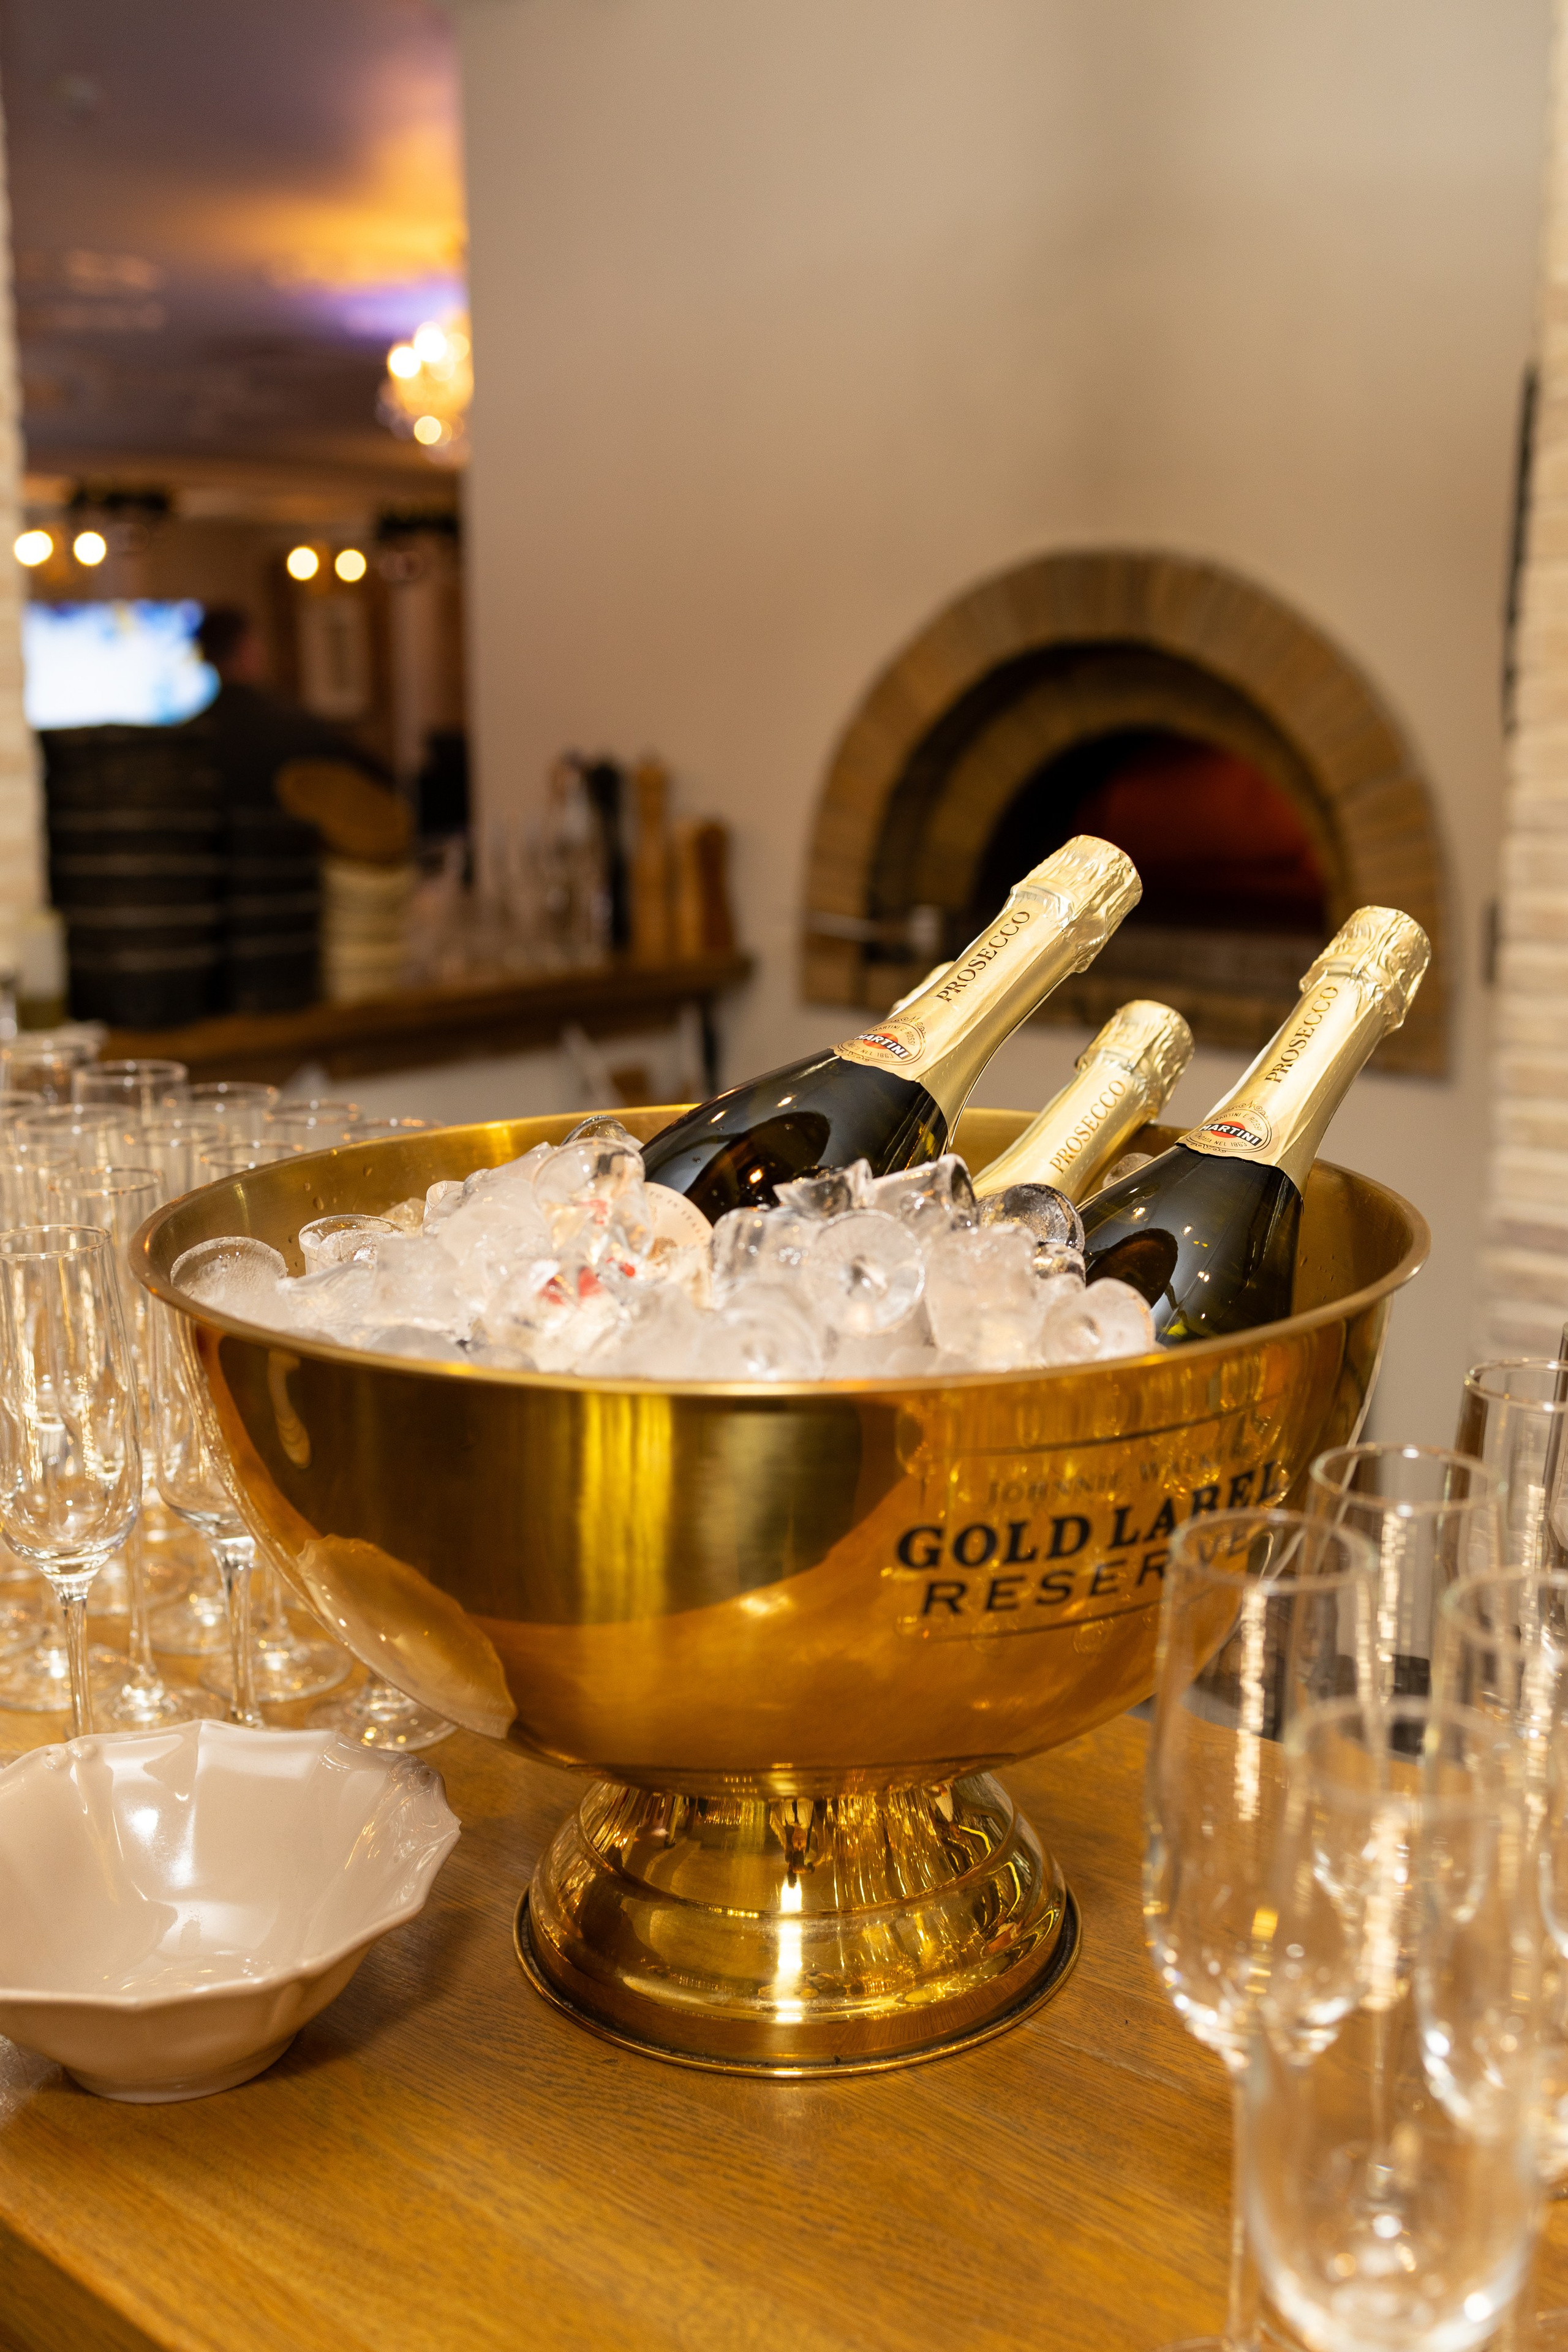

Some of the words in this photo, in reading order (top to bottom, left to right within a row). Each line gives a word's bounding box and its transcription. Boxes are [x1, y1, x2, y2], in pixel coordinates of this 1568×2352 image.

[936, 911, 1030, 1002] PROSECCO
[854, 1034, 910, 1058] MARTINI
[905, 1031, 916, 1046] ROSSI
[1264, 987, 1338, 1084] PROSECCO
[1050, 1080, 1126, 1174] PROSECCO
[1198, 1123, 1261, 1144] MARTINI
[1213, 1112, 1242, 1121] MARTINI
[897, 1514, 1091, 1570] GOLD
[1109, 1460, 1283, 1550] LABEL
[922, 1523, 1250, 1617] RESERVE
